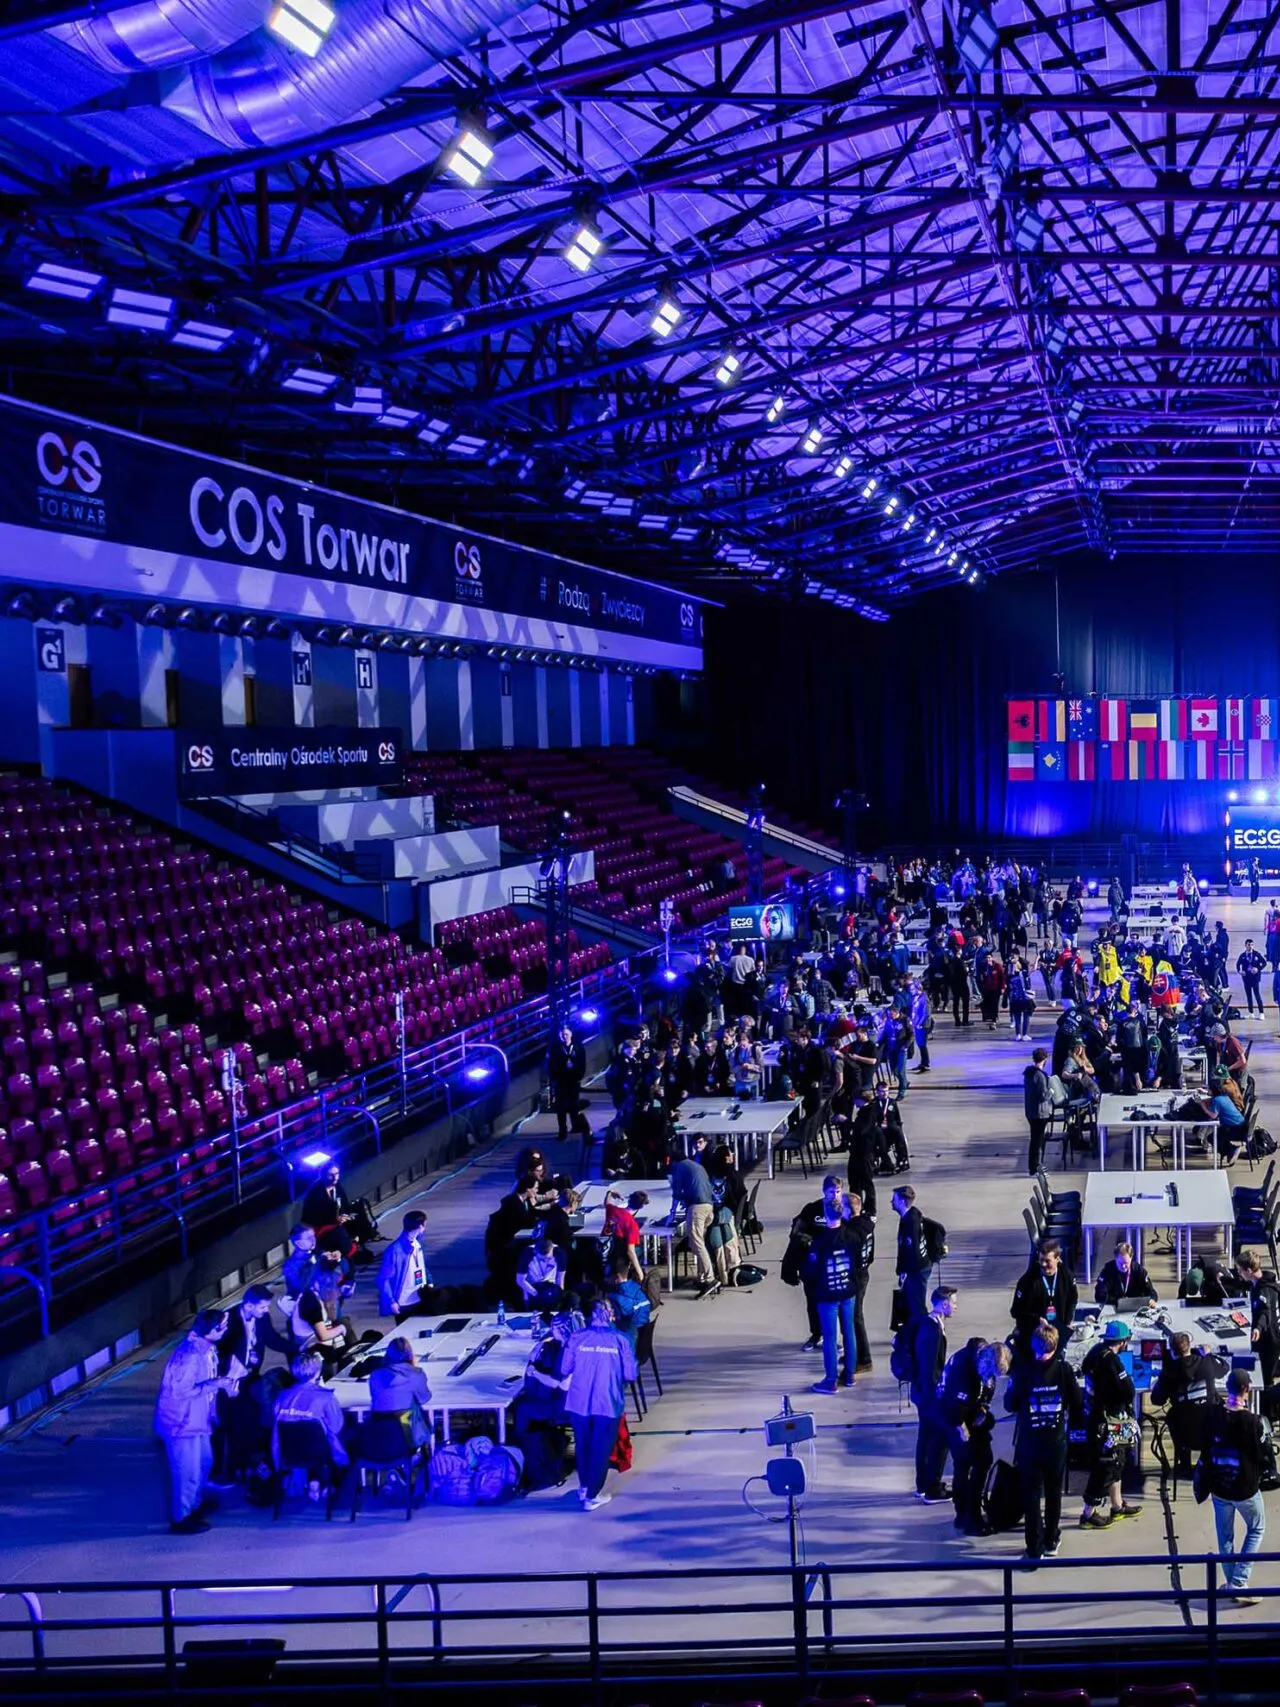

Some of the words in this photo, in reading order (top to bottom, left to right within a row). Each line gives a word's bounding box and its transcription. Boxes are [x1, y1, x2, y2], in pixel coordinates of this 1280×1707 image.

[37, 432, 102, 493] CS
[38, 497, 106, 525] TORWAR
[190, 477, 287, 560] COS
[297, 503, 410, 583] Torwar
[455, 541, 481, 579] CS
[680, 603, 693, 626] CS
[359, 663, 371, 687] H
[188, 745, 214, 767] CS
[231, 747, 288, 770] Centralny
[290, 745, 336, 765] Ośrodek
[337, 745, 368, 766] Sportu
[378, 742, 395, 761] CS
